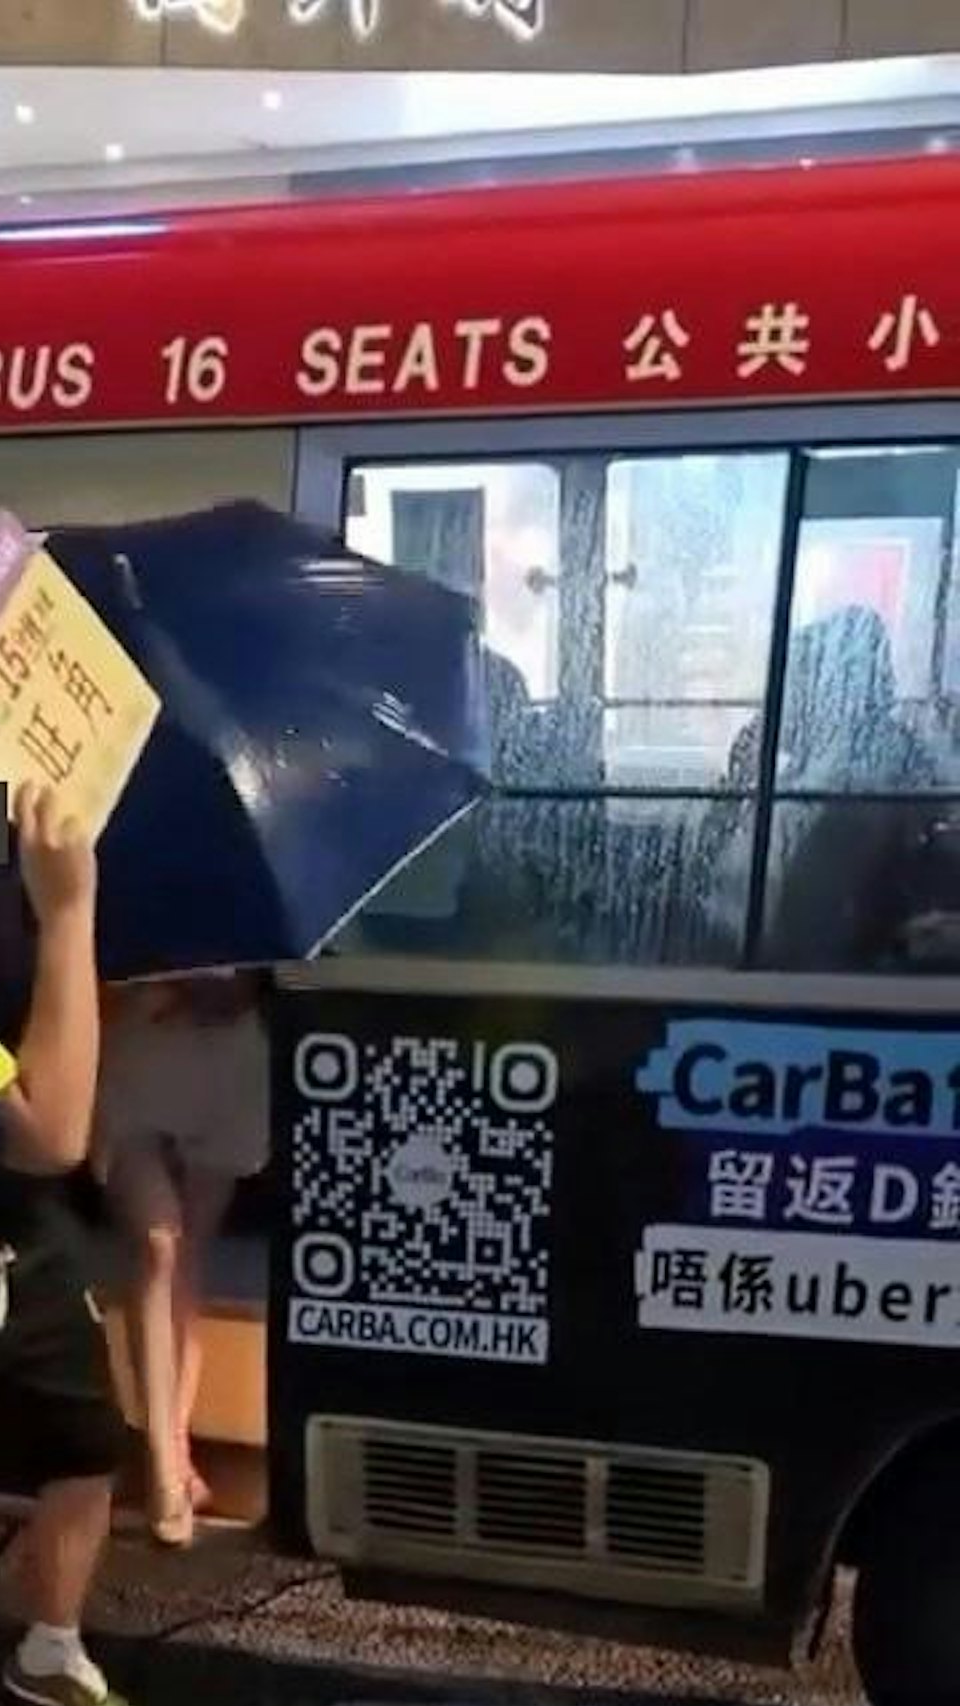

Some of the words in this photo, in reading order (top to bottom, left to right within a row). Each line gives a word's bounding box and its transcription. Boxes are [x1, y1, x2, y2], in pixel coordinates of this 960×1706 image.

[161, 336, 228, 404] 16
[296, 317, 551, 396] SEATS
[650, 1248, 960, 1325] 唔係uber
[296, 1304, 539, 1356] CARBA.COM.HK
